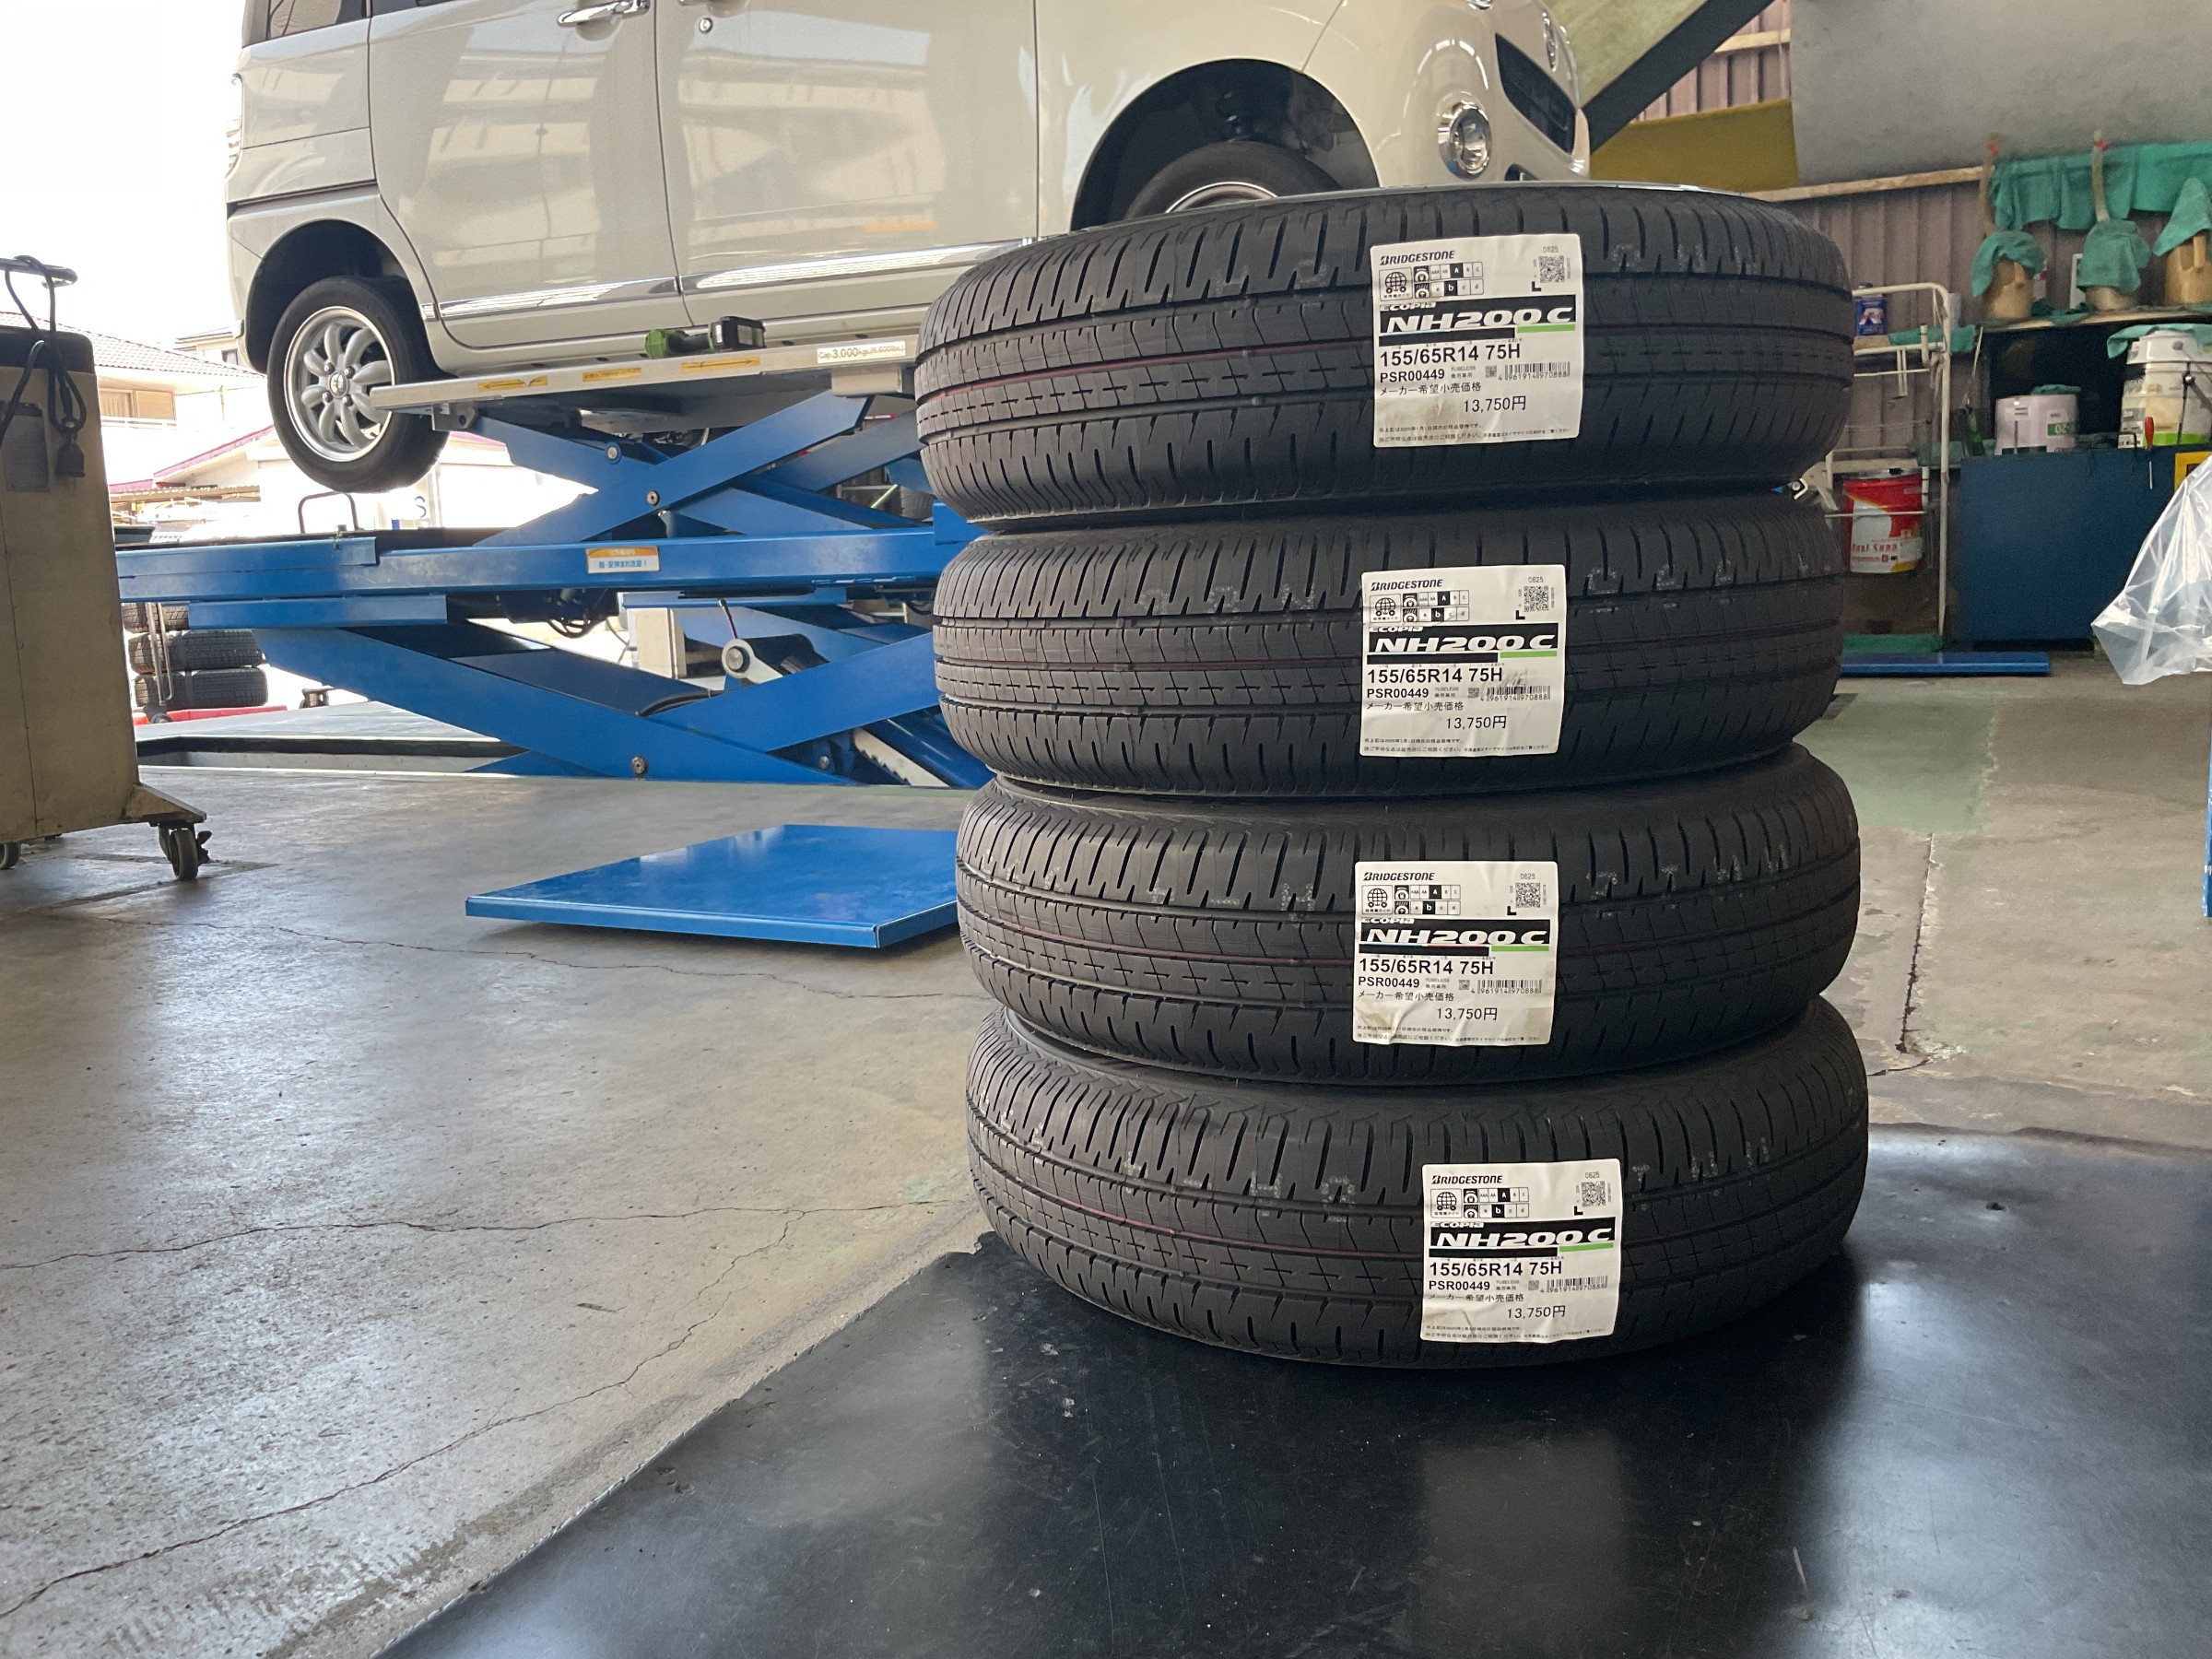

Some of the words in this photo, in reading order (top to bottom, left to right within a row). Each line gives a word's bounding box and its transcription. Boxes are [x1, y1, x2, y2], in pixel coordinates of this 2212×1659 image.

[1380, 250, 1456, 265] BRIDGESTONE
[1532, 281, 1541, 292] L
[1380, 346, 1479, 367] 155/65R14
[1485, 343, 1521, 360] 75H
[1380, 369, 1445, 383] PSR00449
[1380, 382, 1481, 396] メーカー希望小売価格
[1464, 395, 1526, 413] 13,750円
[1371, 579, 1443, 592] BRIDGESTONE
[1515, 610, 1525, 619] L
[1367, 668, 1463, 684] 155/65R14
[1468, 667, 1502, 682] 75H
[1367, 688, 1430, 699] PSR00449
[1366, 701, 1465, 712] メーカー希望小売価格
[1446, 715, 1507, 730] 13,750円
[1363, 872, 1435, 881] BRIDGESTONE
[1507, 905, 1517, 915] L
[1359, 959, 1453, 974] 155/65R14
[1460, 960, 1494, 975] 75H
[1358, 976, 1420, 988] PSR00449
[1358, 991, 1454, 1002] メーカー希望小売価格
[1437, 1007, 1498, 1020] 13,750円
[1431, 1175, 1503, 1184] BRIDGESTONE
[1574, 1206, 1583, 1216] L
[1430, 1262, 1523, 1277] 155/65R14
[1529, 1261, 1561, 1276] 75H
[1430, 1280, 1490, 1290] PSR00449
[1429, 1294, 1524, 1302] メーカー希望小売価格
[1507, 1305, 1566, 1319] 13,750円
